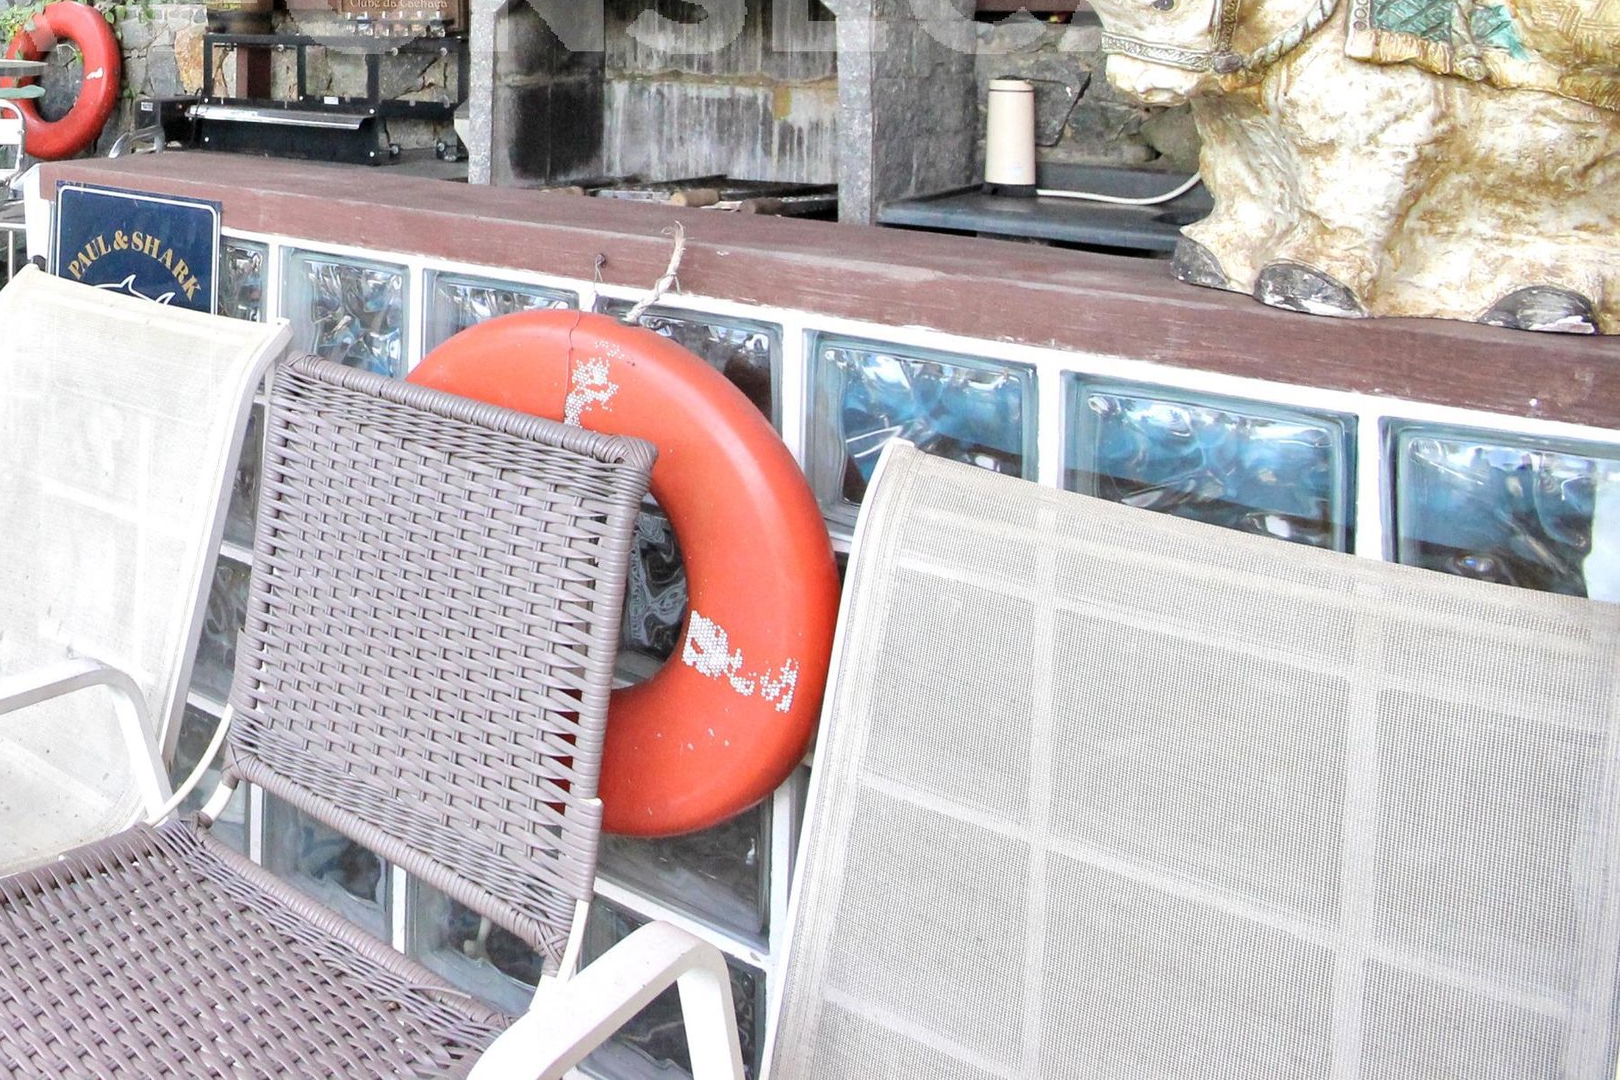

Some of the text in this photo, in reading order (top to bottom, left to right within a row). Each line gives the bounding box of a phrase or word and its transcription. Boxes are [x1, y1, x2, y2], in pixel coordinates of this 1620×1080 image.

[68, 230, 202, 302] PAUL & SHARK
